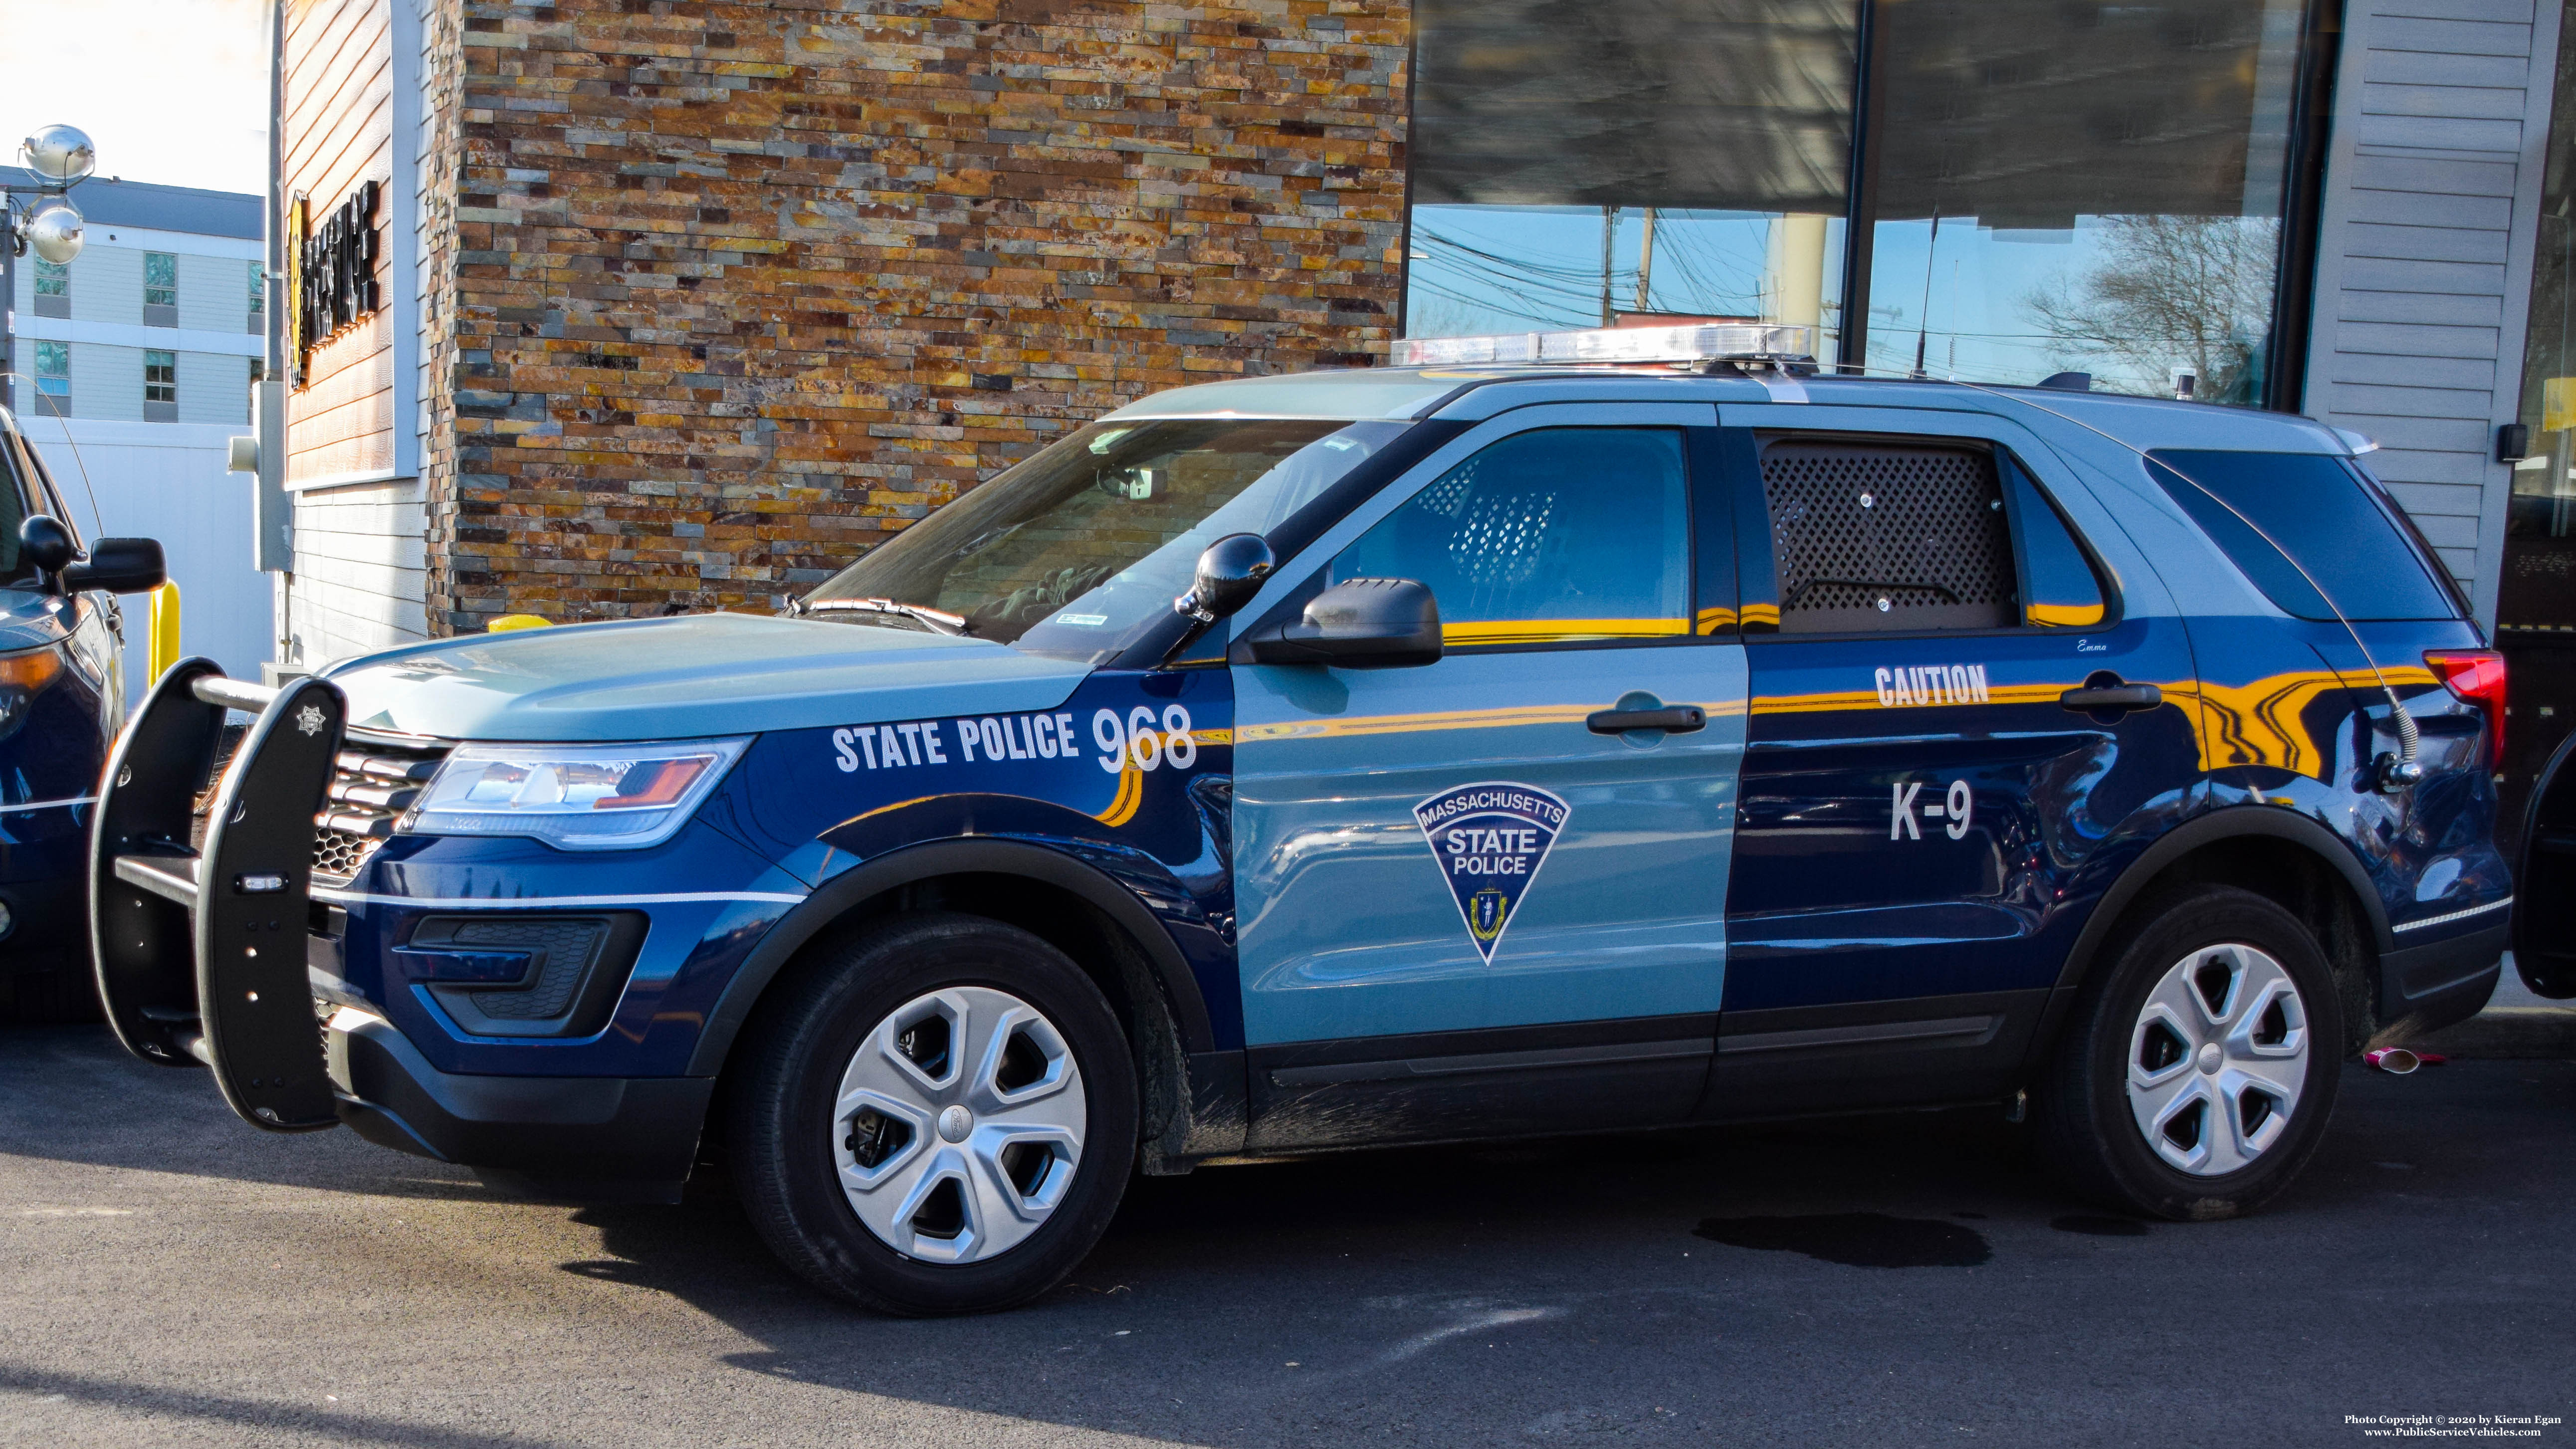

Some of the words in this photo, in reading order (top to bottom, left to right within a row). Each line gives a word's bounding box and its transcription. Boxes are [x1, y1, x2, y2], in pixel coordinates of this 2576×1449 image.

[2077, 639, 2106, 651] Emma
[1875, 665, 1988, 706] CAUTION
[833, 722, 947, 772] STATE
[958, 713, 1079, 761] POLICE
[1092, 704, 1198, 774] 968
[1420, 792, 1563, 827] MASSACHUSETTS
[1891, 780, 1971, 840] K-9
[1447, 829, 1537, 853] STATE
[1454, 856, 1526, 875] POLICE
